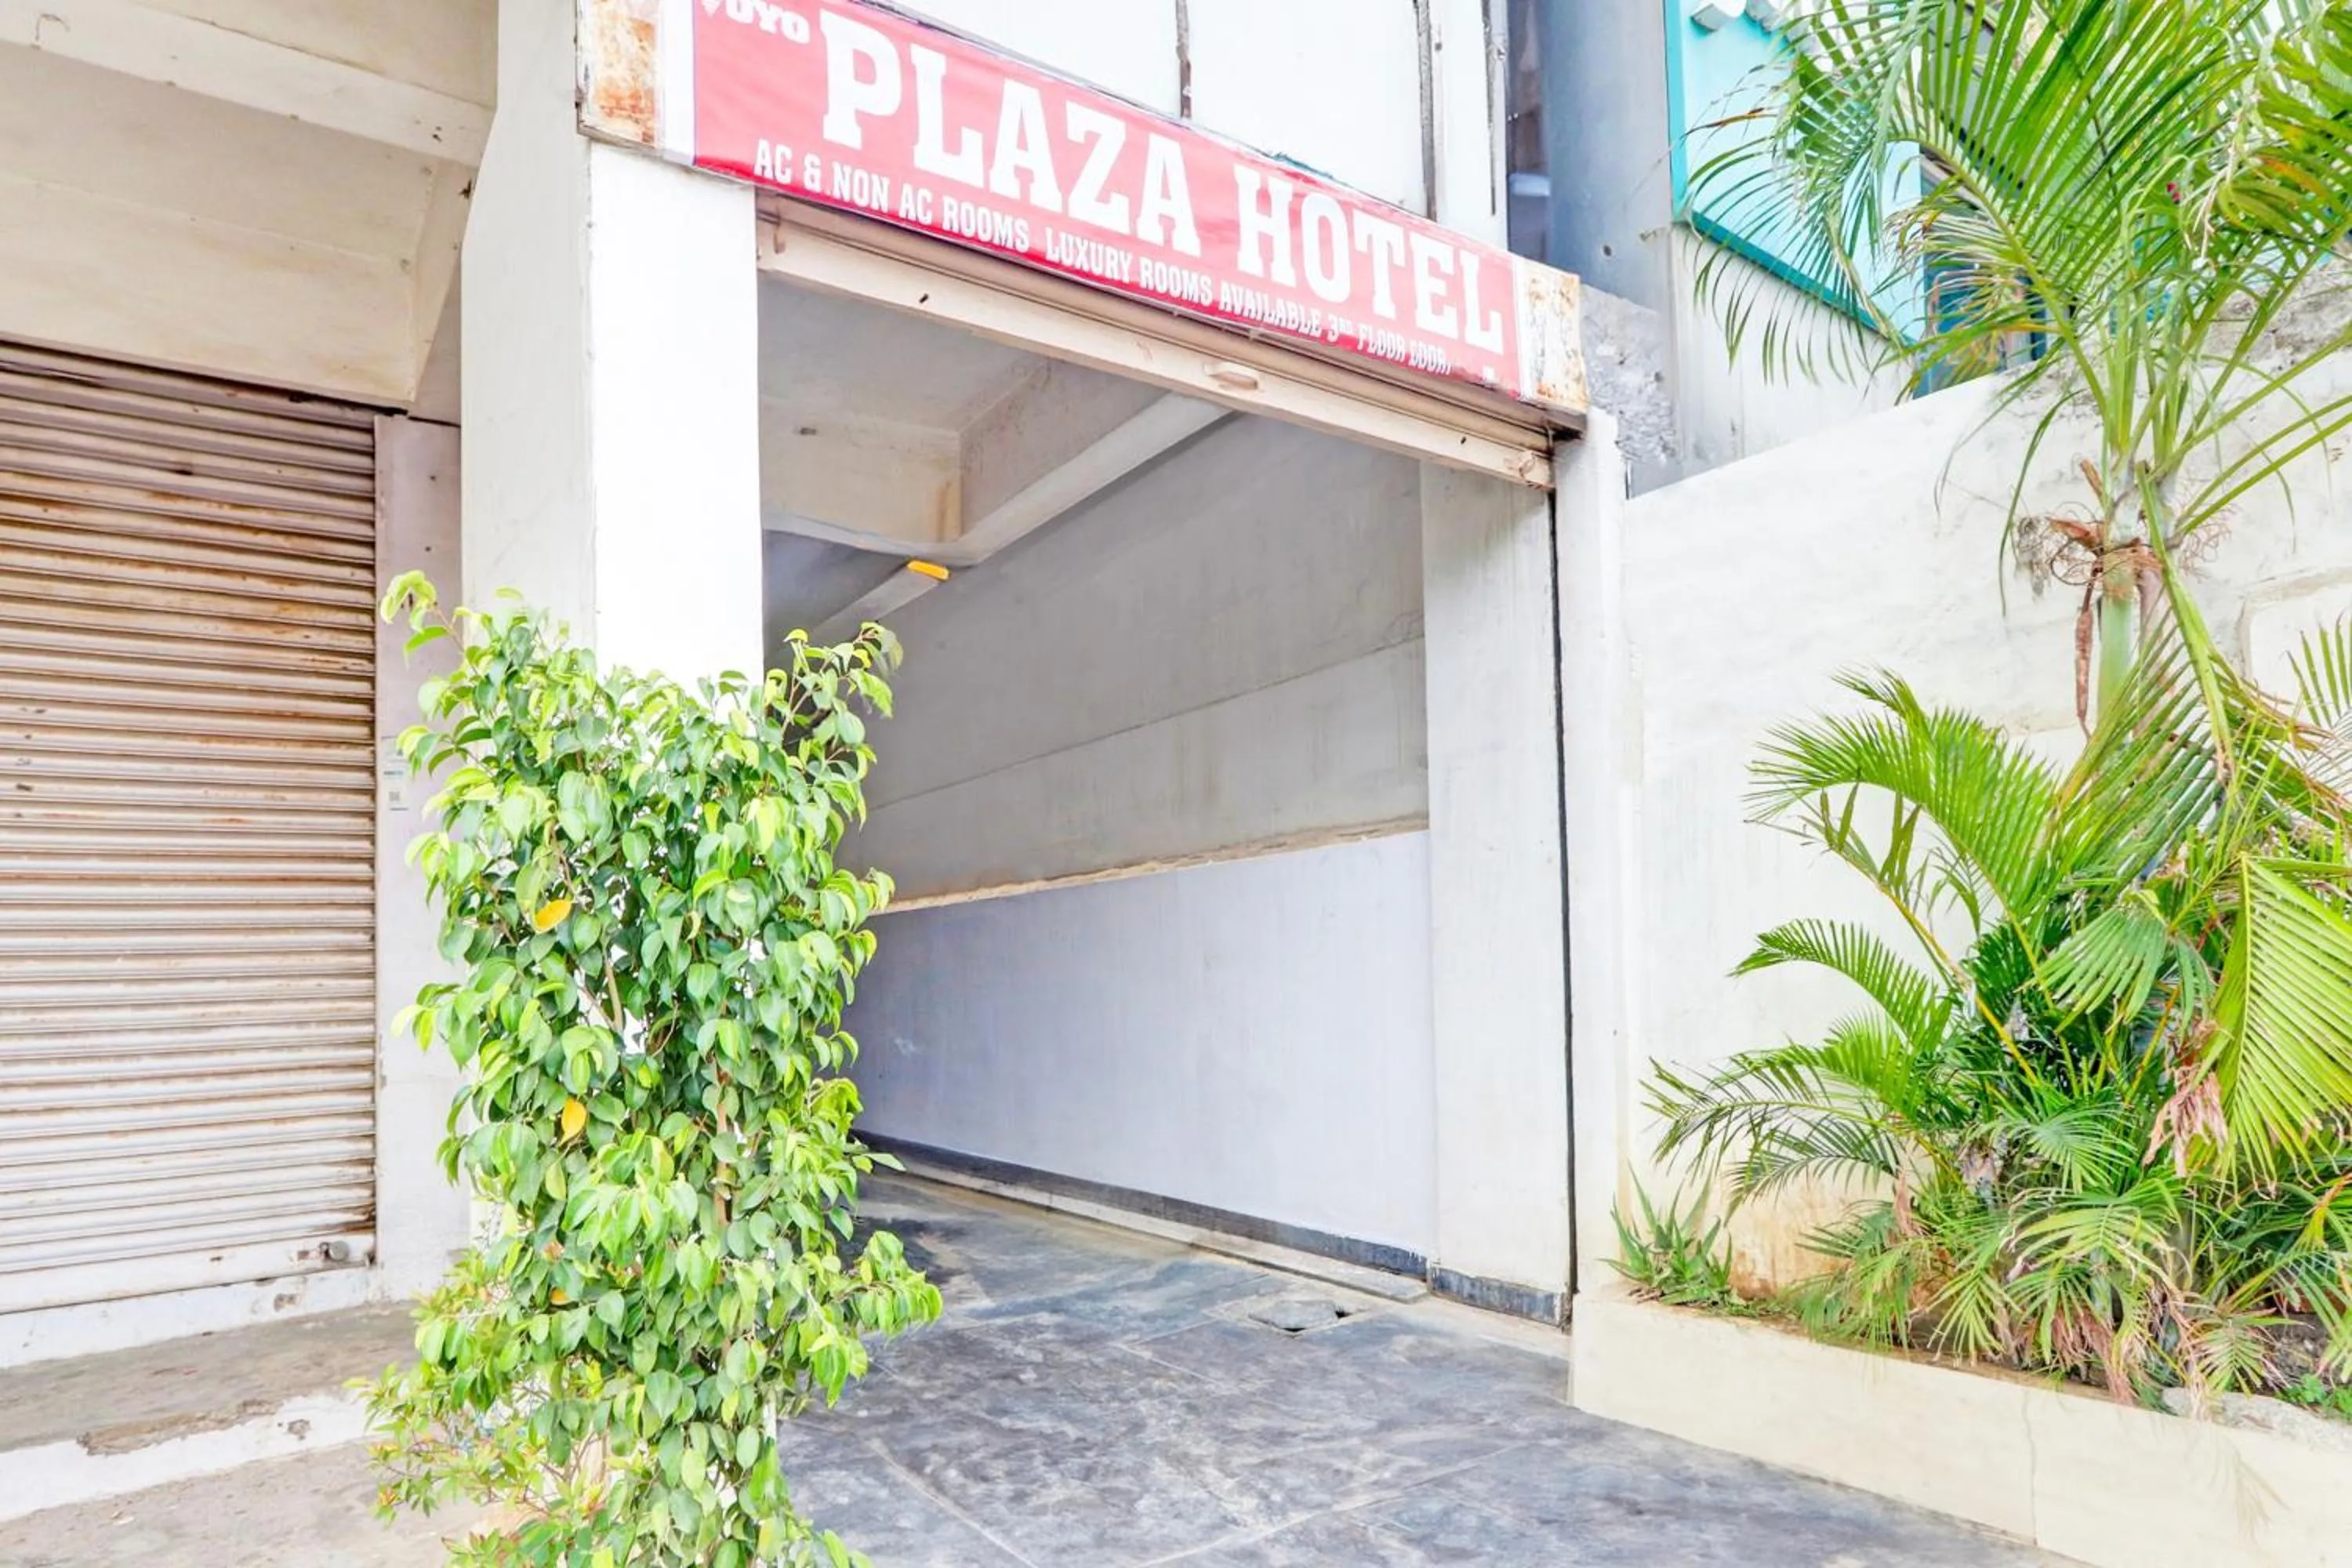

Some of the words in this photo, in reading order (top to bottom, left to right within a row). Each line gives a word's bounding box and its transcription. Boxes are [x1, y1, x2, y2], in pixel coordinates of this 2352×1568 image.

[753, 139, 792, 184] AC
[804, 153, 822, 192] &
[832, 162, 891, 213] NON
[899, 183, 933, 225] AC
[942, 195, 1030, 253] ROOMS
[1045, 227, 1134, 284] LUXURY
[1139, 256, 1213, 307] ROOMS
[1219, 281, 1322, 337] AVAILABLE
[1357, 323, 1406, 362] FLOOR
[819, 8, 1201, 258] PLAZA
[1234, 163, 1504, 355] HOTEL
